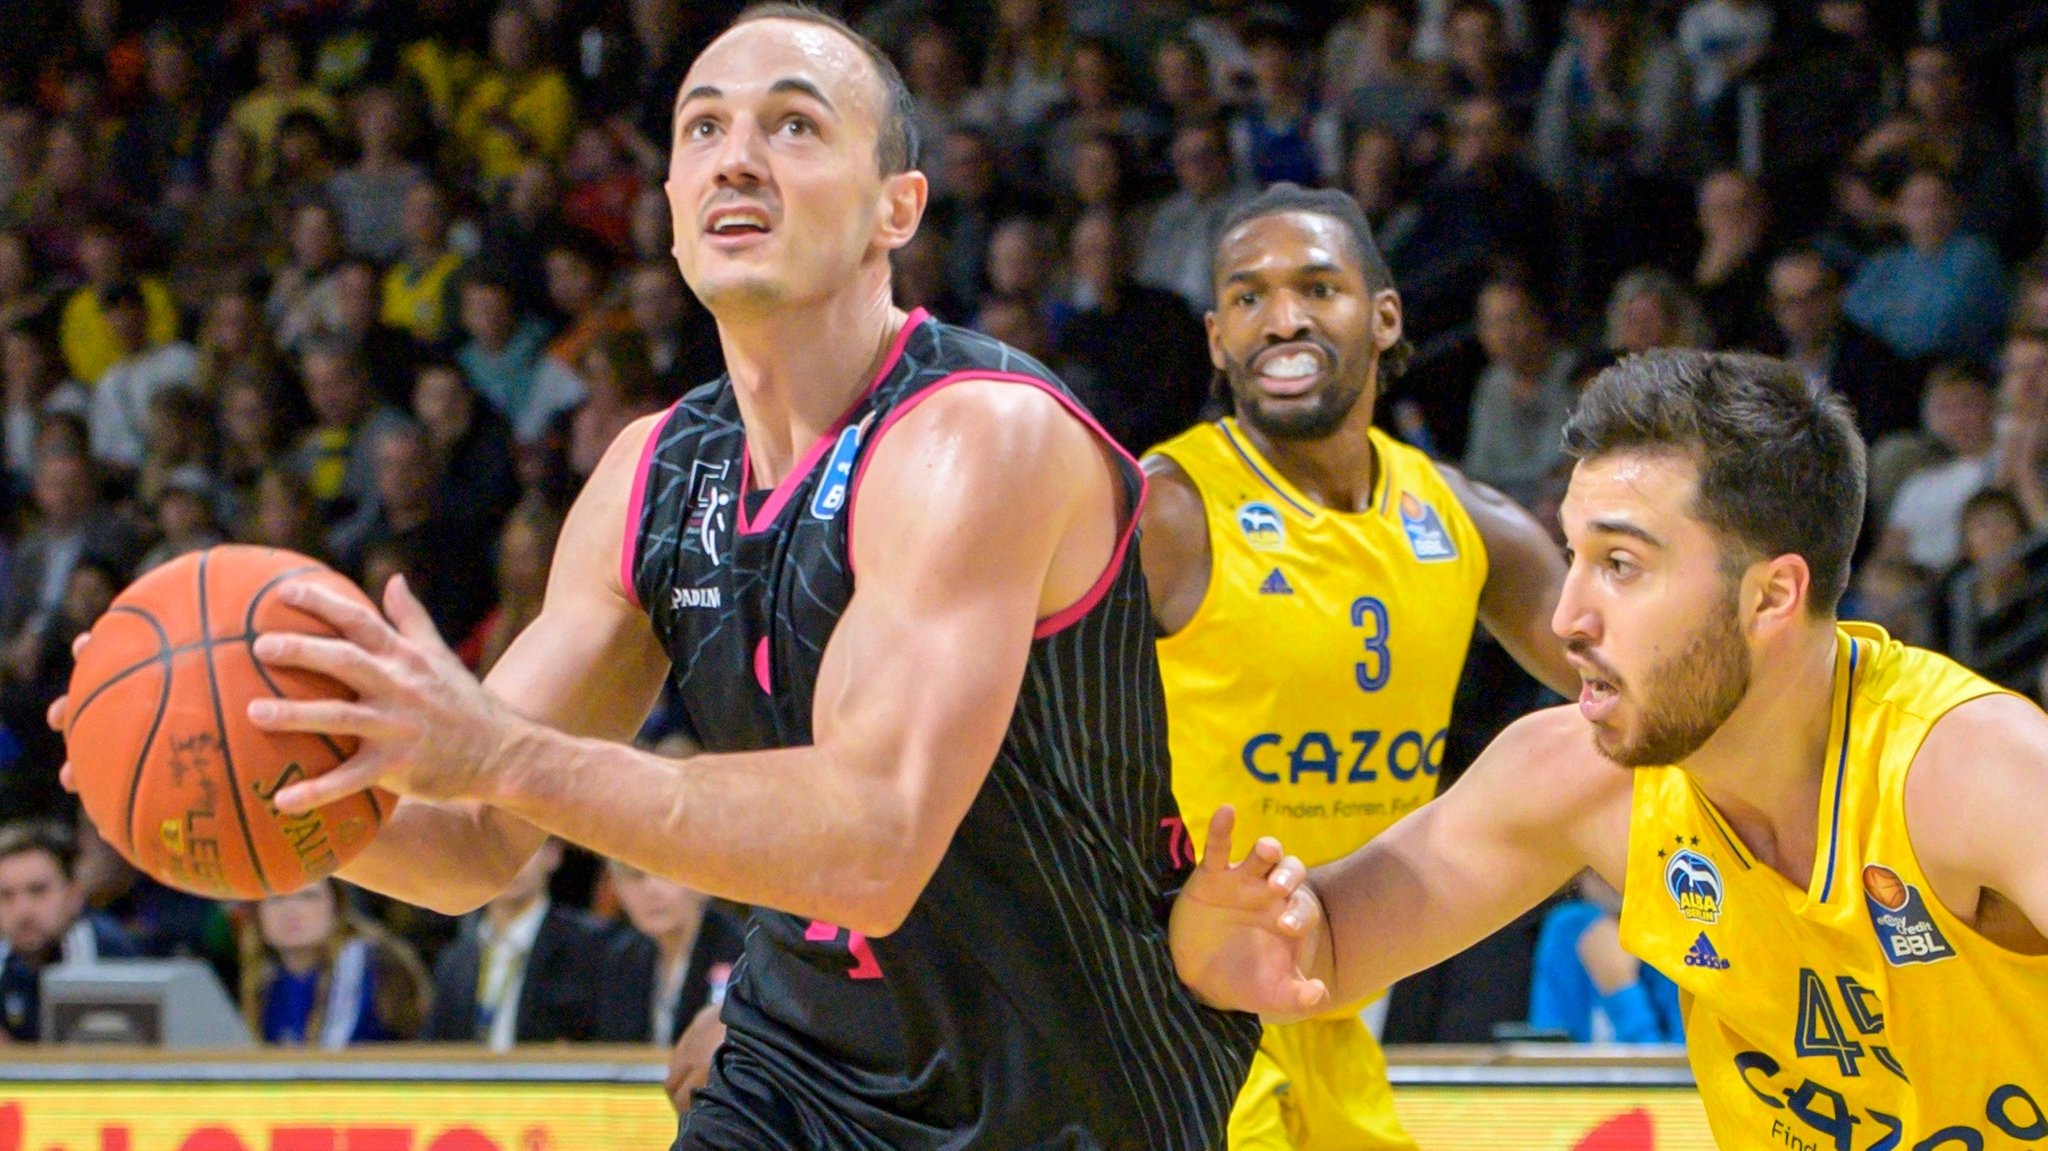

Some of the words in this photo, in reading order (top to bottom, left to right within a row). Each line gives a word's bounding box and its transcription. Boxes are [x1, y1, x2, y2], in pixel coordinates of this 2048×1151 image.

[1351, 596, 1391, 692] 3
[1681, 892, 1718, 913] ALBA
[1891, 932, 1945, 957] BBL
[1684, 955, 1730, 969] adidas
